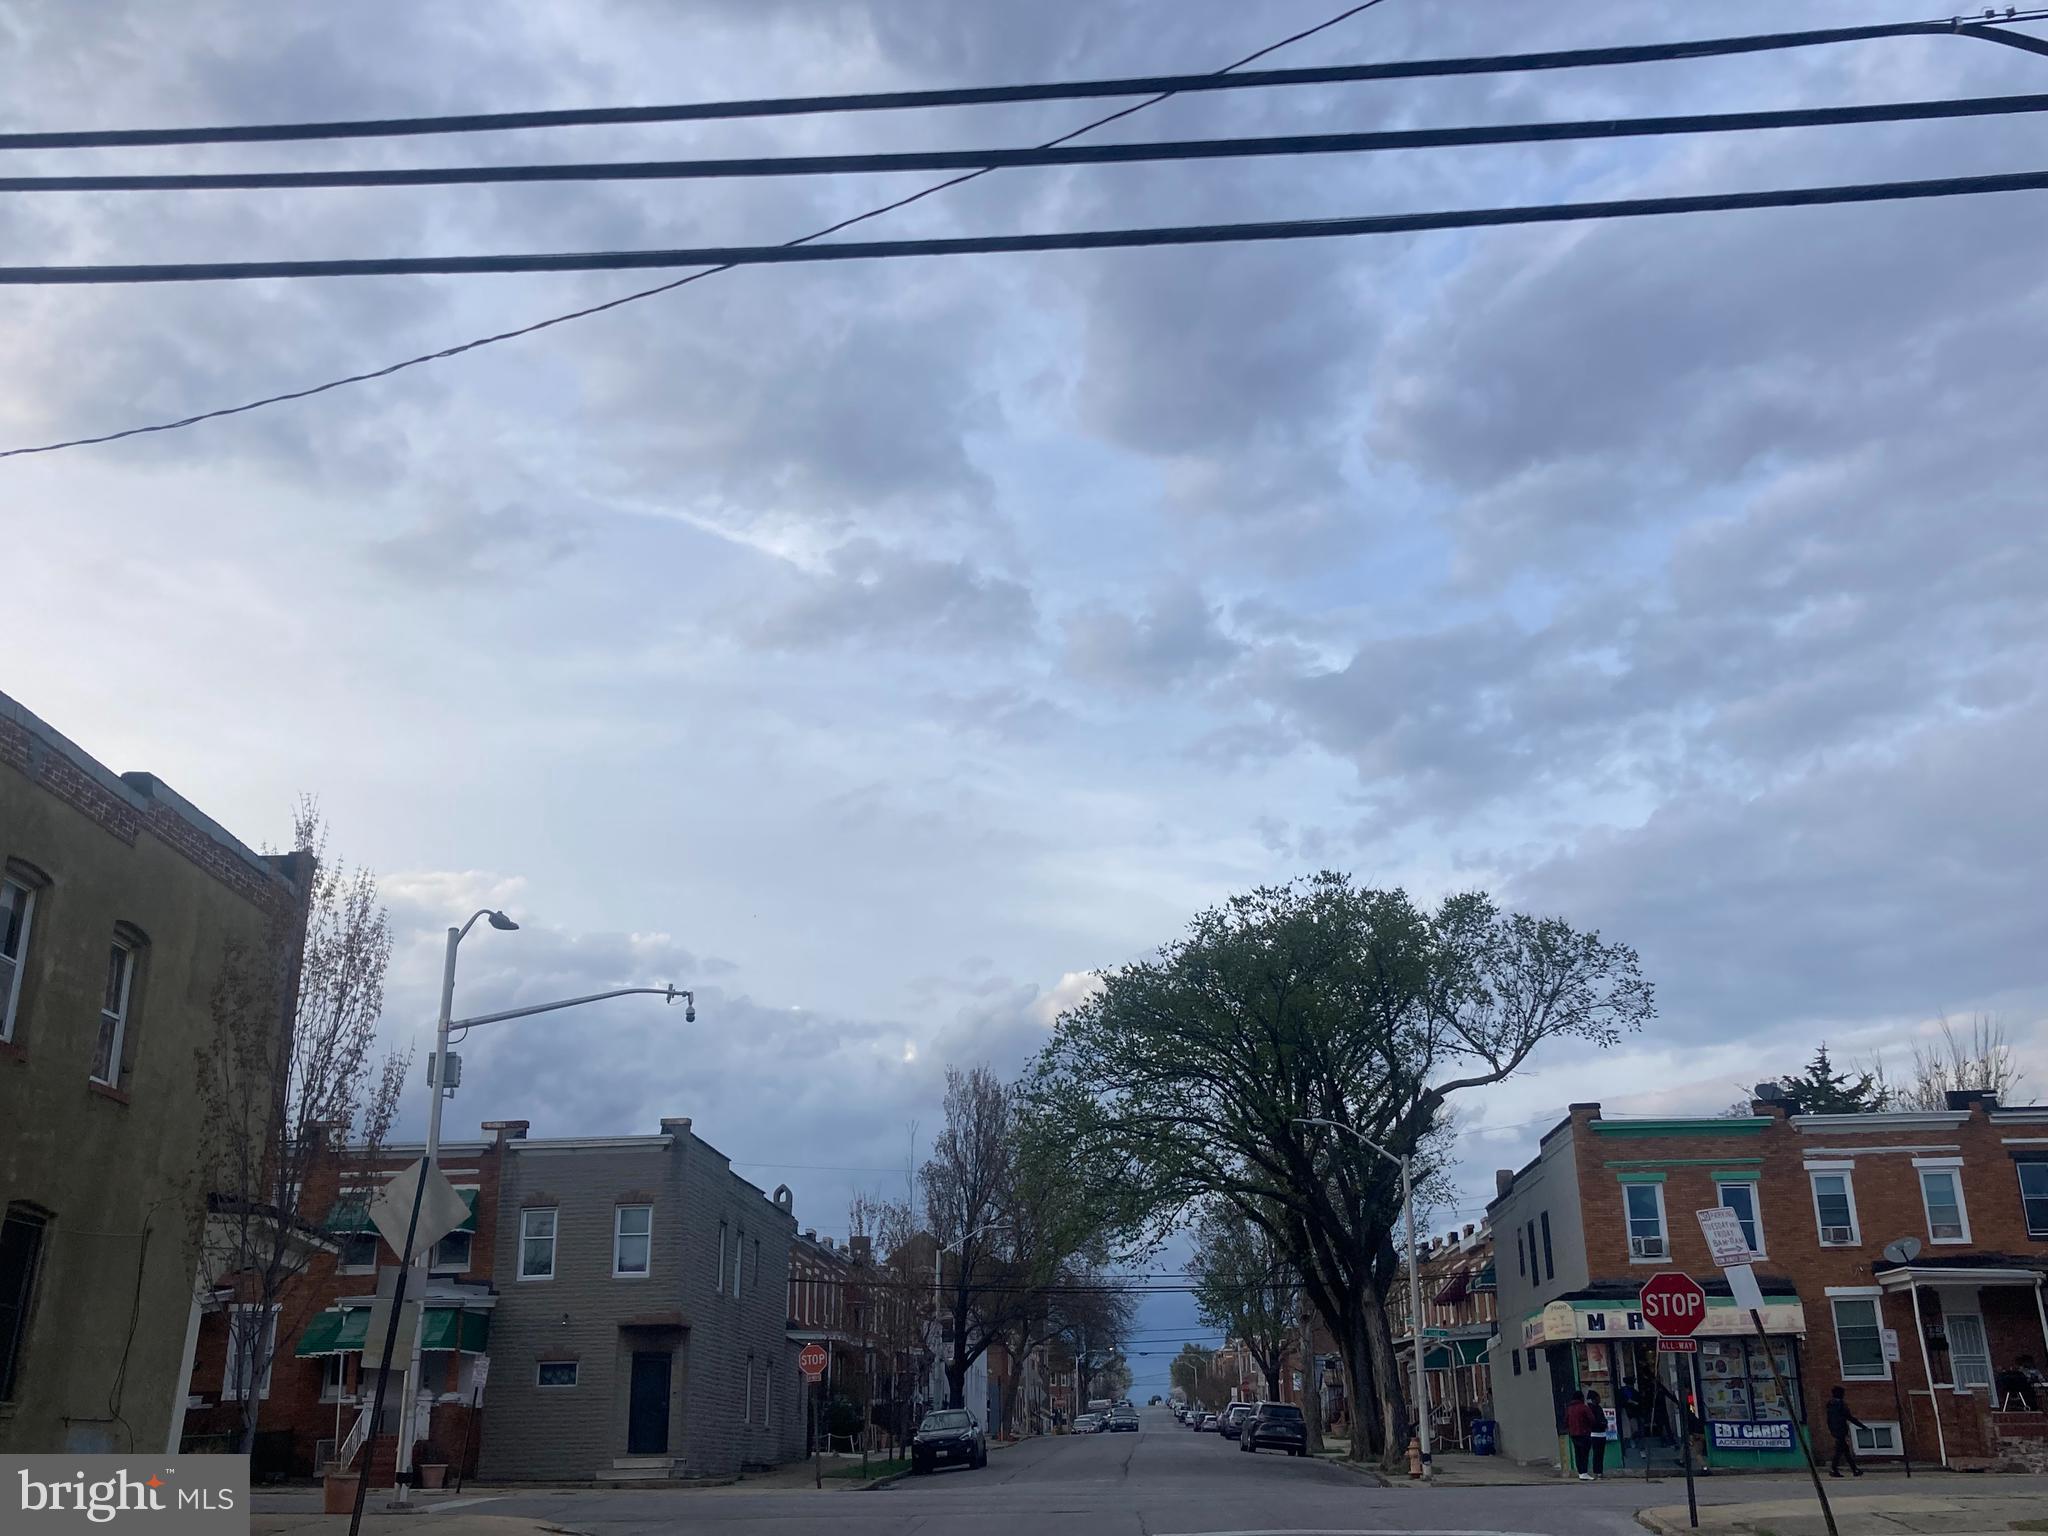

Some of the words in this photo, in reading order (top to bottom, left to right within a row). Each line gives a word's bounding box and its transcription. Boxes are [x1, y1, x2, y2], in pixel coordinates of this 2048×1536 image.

[1713, 1230, 1735, 1238] FRIDAY
[1645, 1293, 1701, 1317] STOP
[1586, 1312, 1606, 1331] M
[1626, 1312, 1646, 1331] R
[801, 1354, 825, 1366] STOP
[1714, 1423, 1740, 1437] EBT
[1742, 1424, 1790, 1438] CARDS
[1718, 1438, 1764, 1446] ACCEPTED
